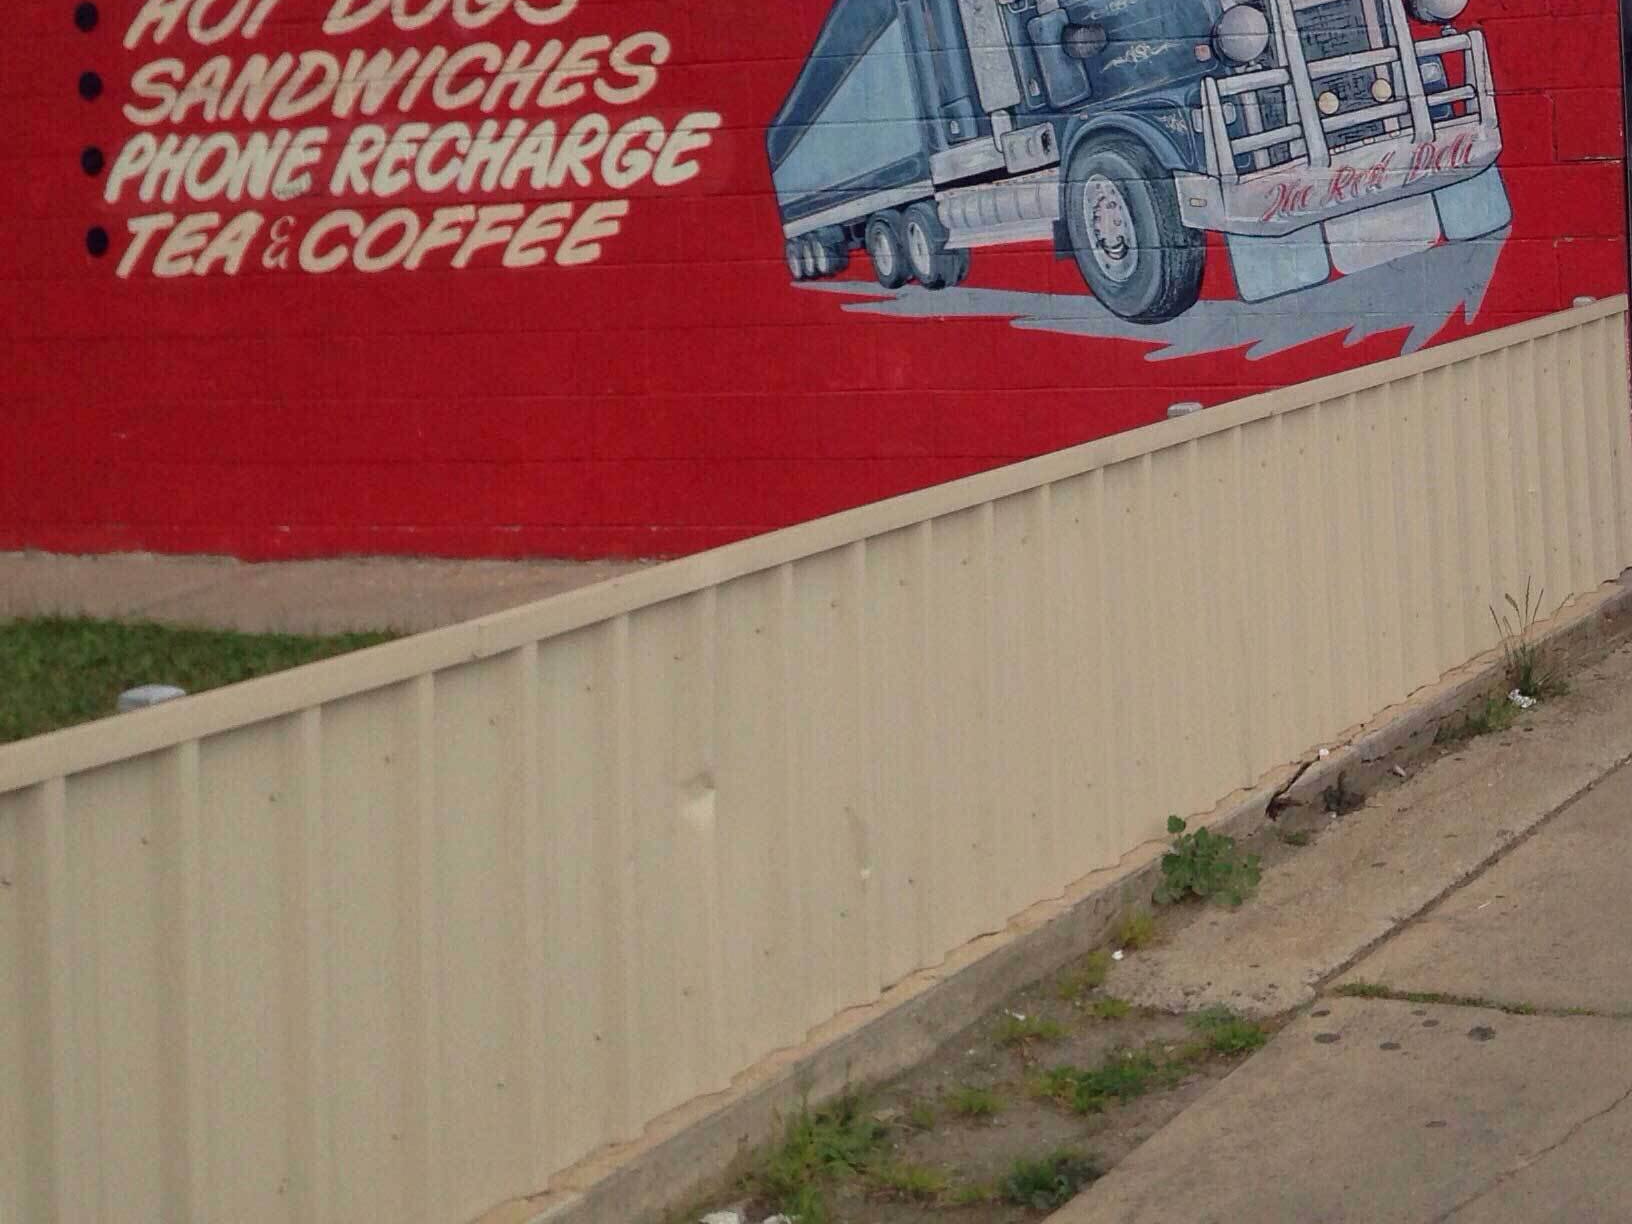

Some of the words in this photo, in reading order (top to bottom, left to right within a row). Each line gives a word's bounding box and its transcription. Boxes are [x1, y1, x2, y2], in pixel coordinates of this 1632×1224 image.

[122, 31, 671, 125] SANDWICHES
[103, 126, 328, 203] PHONE
[329, 112, 722, 198] RECHARGE
[115, 211, 264, 279] TEA
[299, 200, 629, 273] COFFEE
